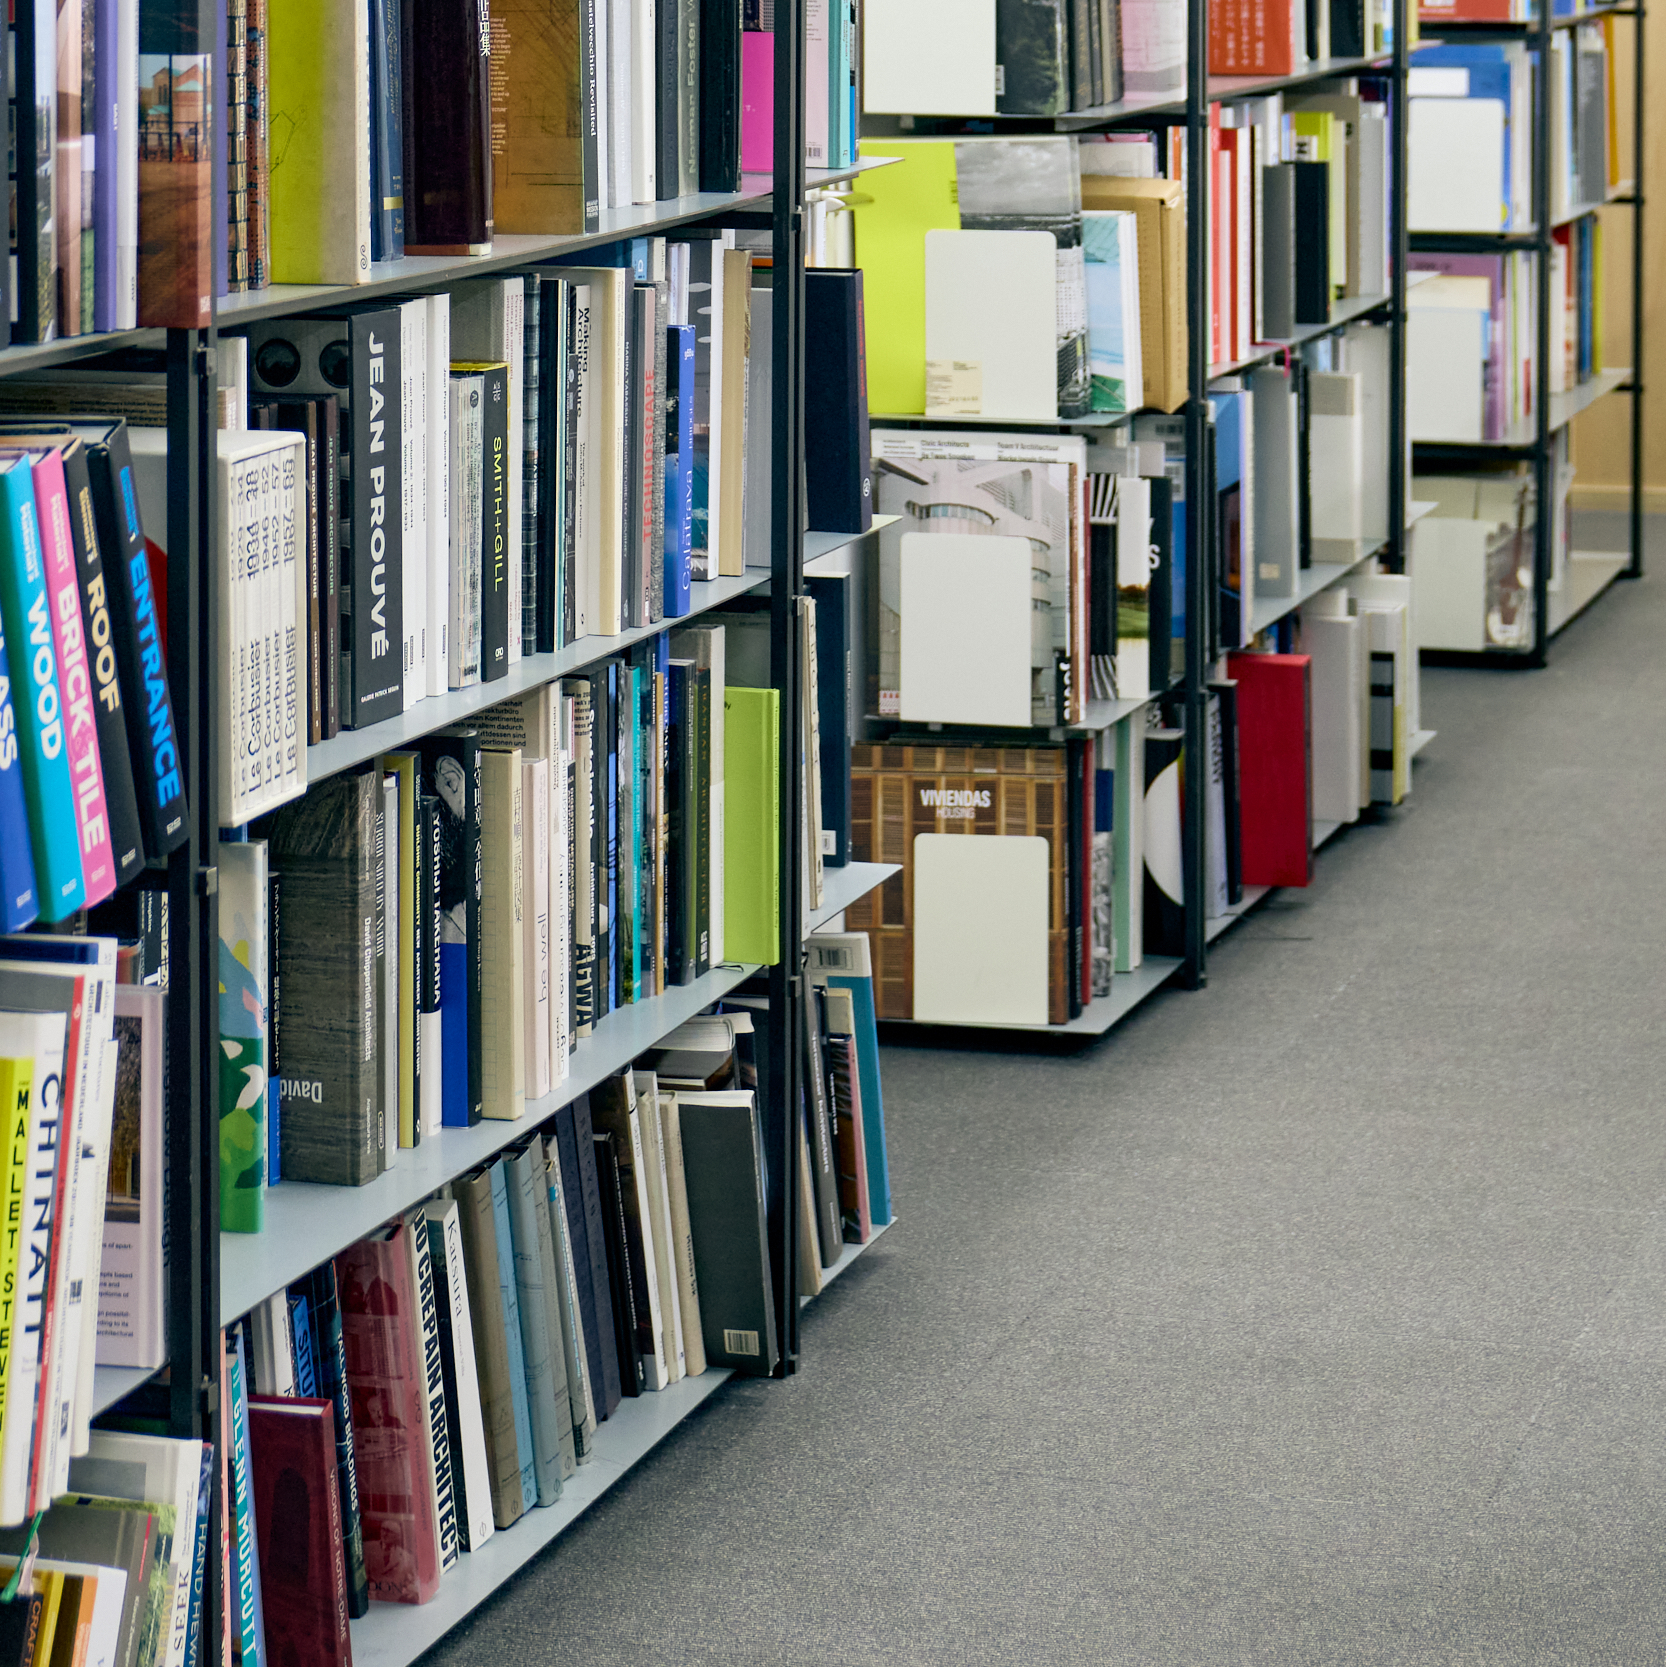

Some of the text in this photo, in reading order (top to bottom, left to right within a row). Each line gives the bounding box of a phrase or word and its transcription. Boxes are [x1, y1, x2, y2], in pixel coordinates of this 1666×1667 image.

[589, 78, 597, 138] Revisited
[582, 306, 590, 373] Making
[368, 331, 390, 661] JEAN PROUVÉ
[493, 436, 503, 593] SMITH+GILL
[643, 369, 655, 543] TECHNOSCAPE
[682, 470, 693, 591] Calatrava
[27, 590, 63, 761] WOOD
[57, 582, 106, 854] BRICK TILE
[86, 577, 120, 714] ROOF
[130, 549, 180, 809] ENTRANCE
[919, 789, 991, 808] VIVIENDAS
[936, 806, 976, 820] HOUSING
[363, 915, 371, 947] David
[364, 948, 372, 1012] Chipperfield
[432, 814, 442, 1004] YOSHIJI TAKEHARA
[538, 912, 548, 1003] be well
[24, 1072, 60, 1335] CHINATI
[446, 1218, 464, 1318] Katsura
[337, 1329, 358, 1511] TALL WOOD BUILDINGS
[417, 1246, 458, 1568] CREPAIN ARCHITECT
[233, 1398, 258, 1658] GLENN MURCUTT
[329, 1468, 339, 1526] VISIONS
[335, 1548, 347, 1640] NOTRE-DAME
